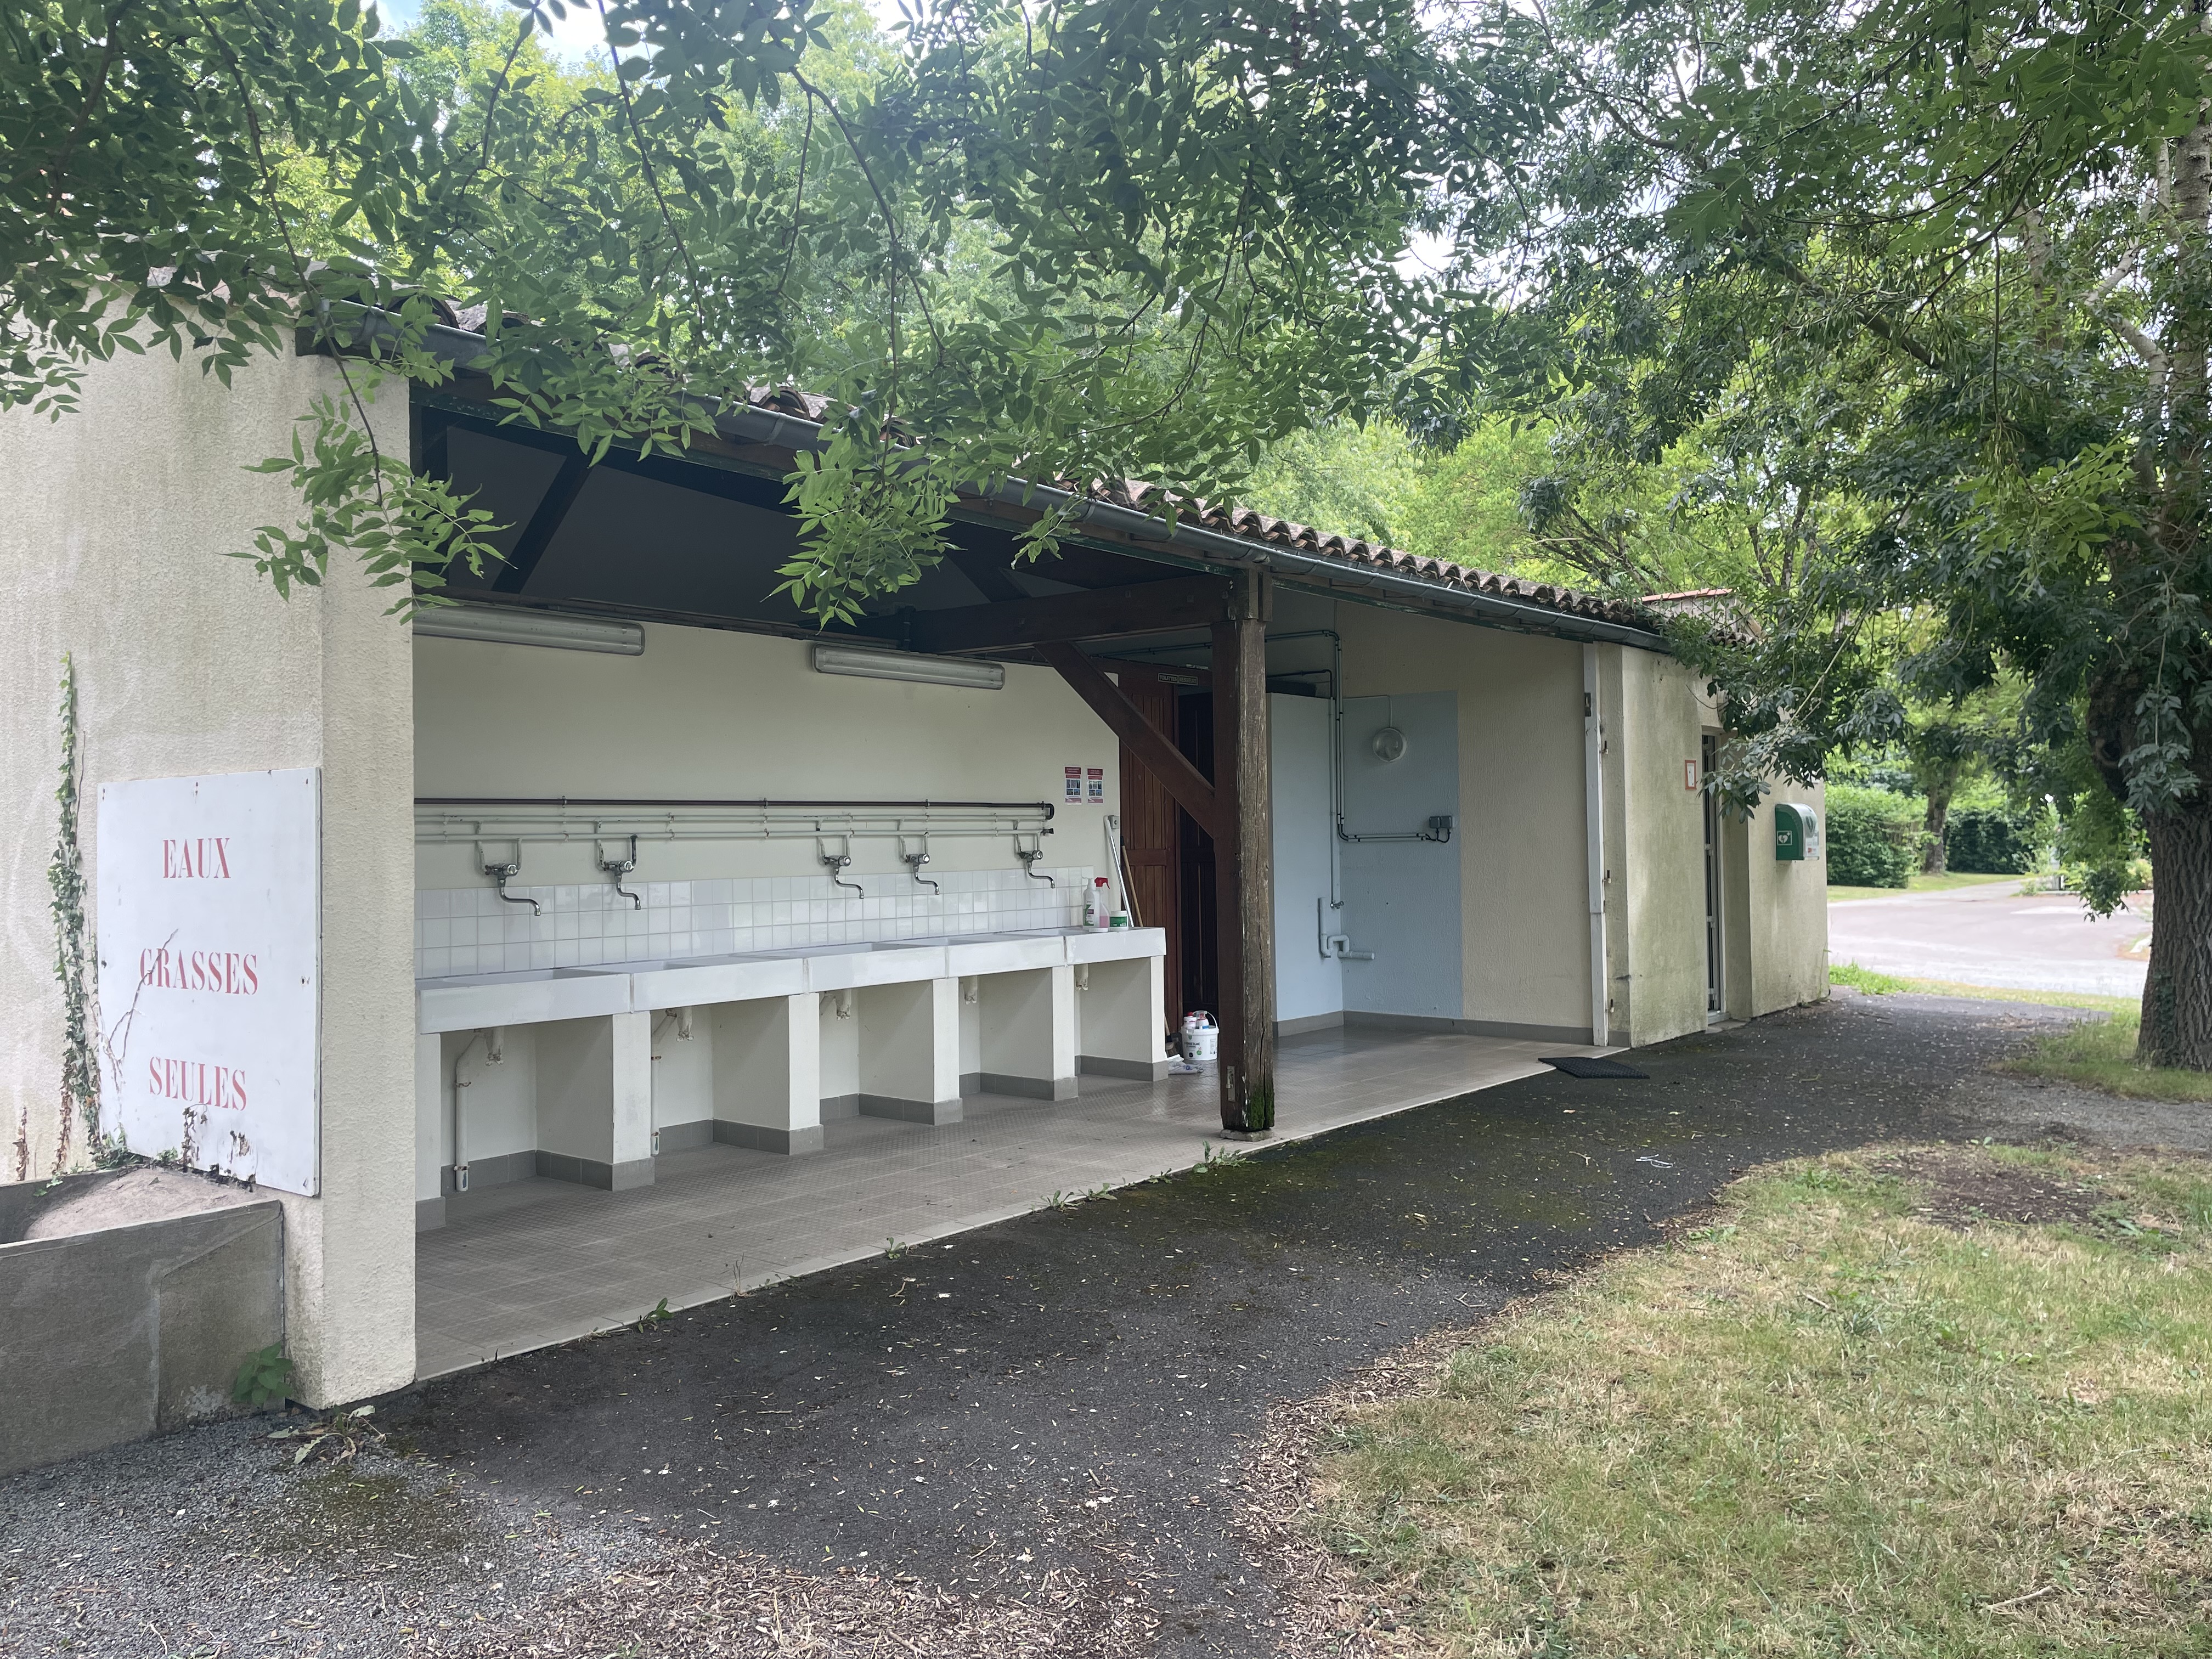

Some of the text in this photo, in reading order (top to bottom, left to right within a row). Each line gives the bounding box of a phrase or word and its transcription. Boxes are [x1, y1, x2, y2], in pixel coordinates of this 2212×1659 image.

[163, 838, 231, 878] EAUX
[140, 948, 258, 995] GRASSES
[149, 1057, 247, 1110] SEULES
